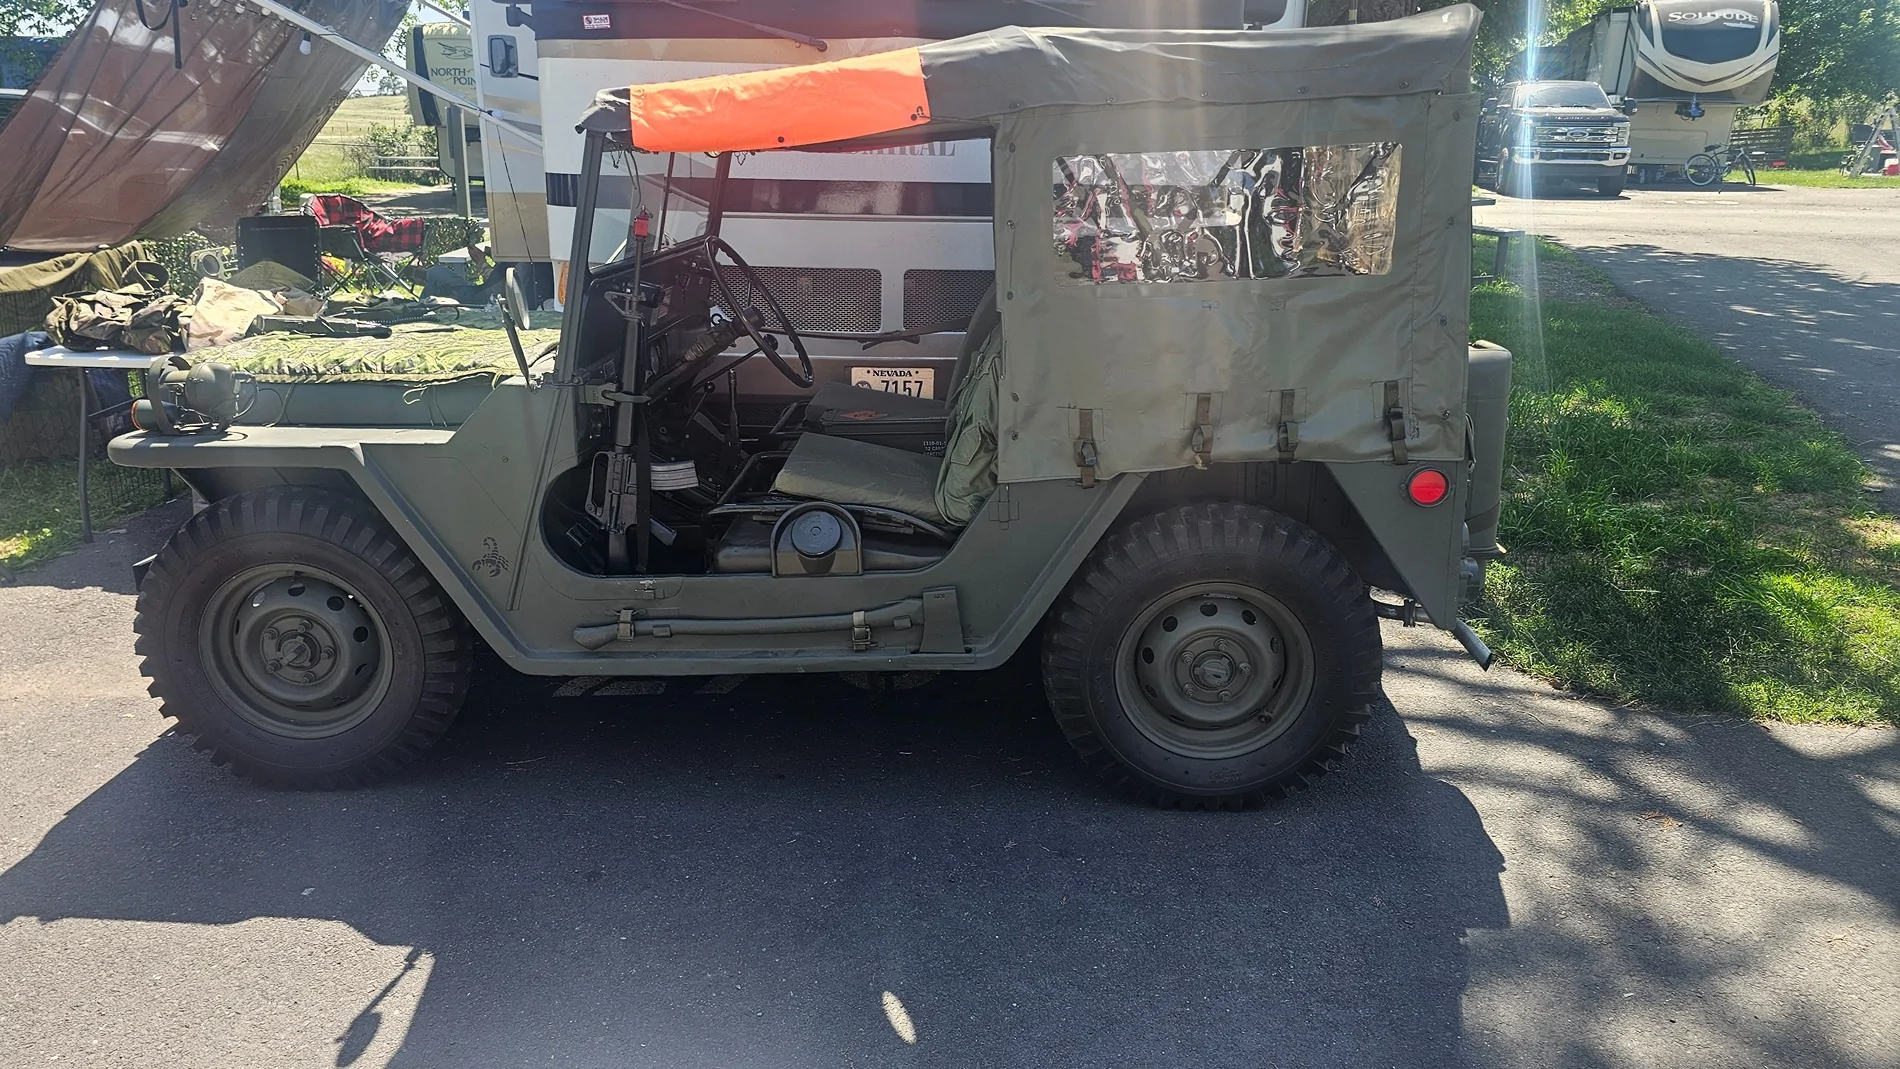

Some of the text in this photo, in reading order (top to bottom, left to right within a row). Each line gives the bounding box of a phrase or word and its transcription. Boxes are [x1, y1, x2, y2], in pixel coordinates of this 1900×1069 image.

[1668, 12, 1758, 23] SOLITUDE
[431, 68, 466, 76] NORTH
[453, 77, 476, 85] POIN
[881, 380, 923, 398] 7157
